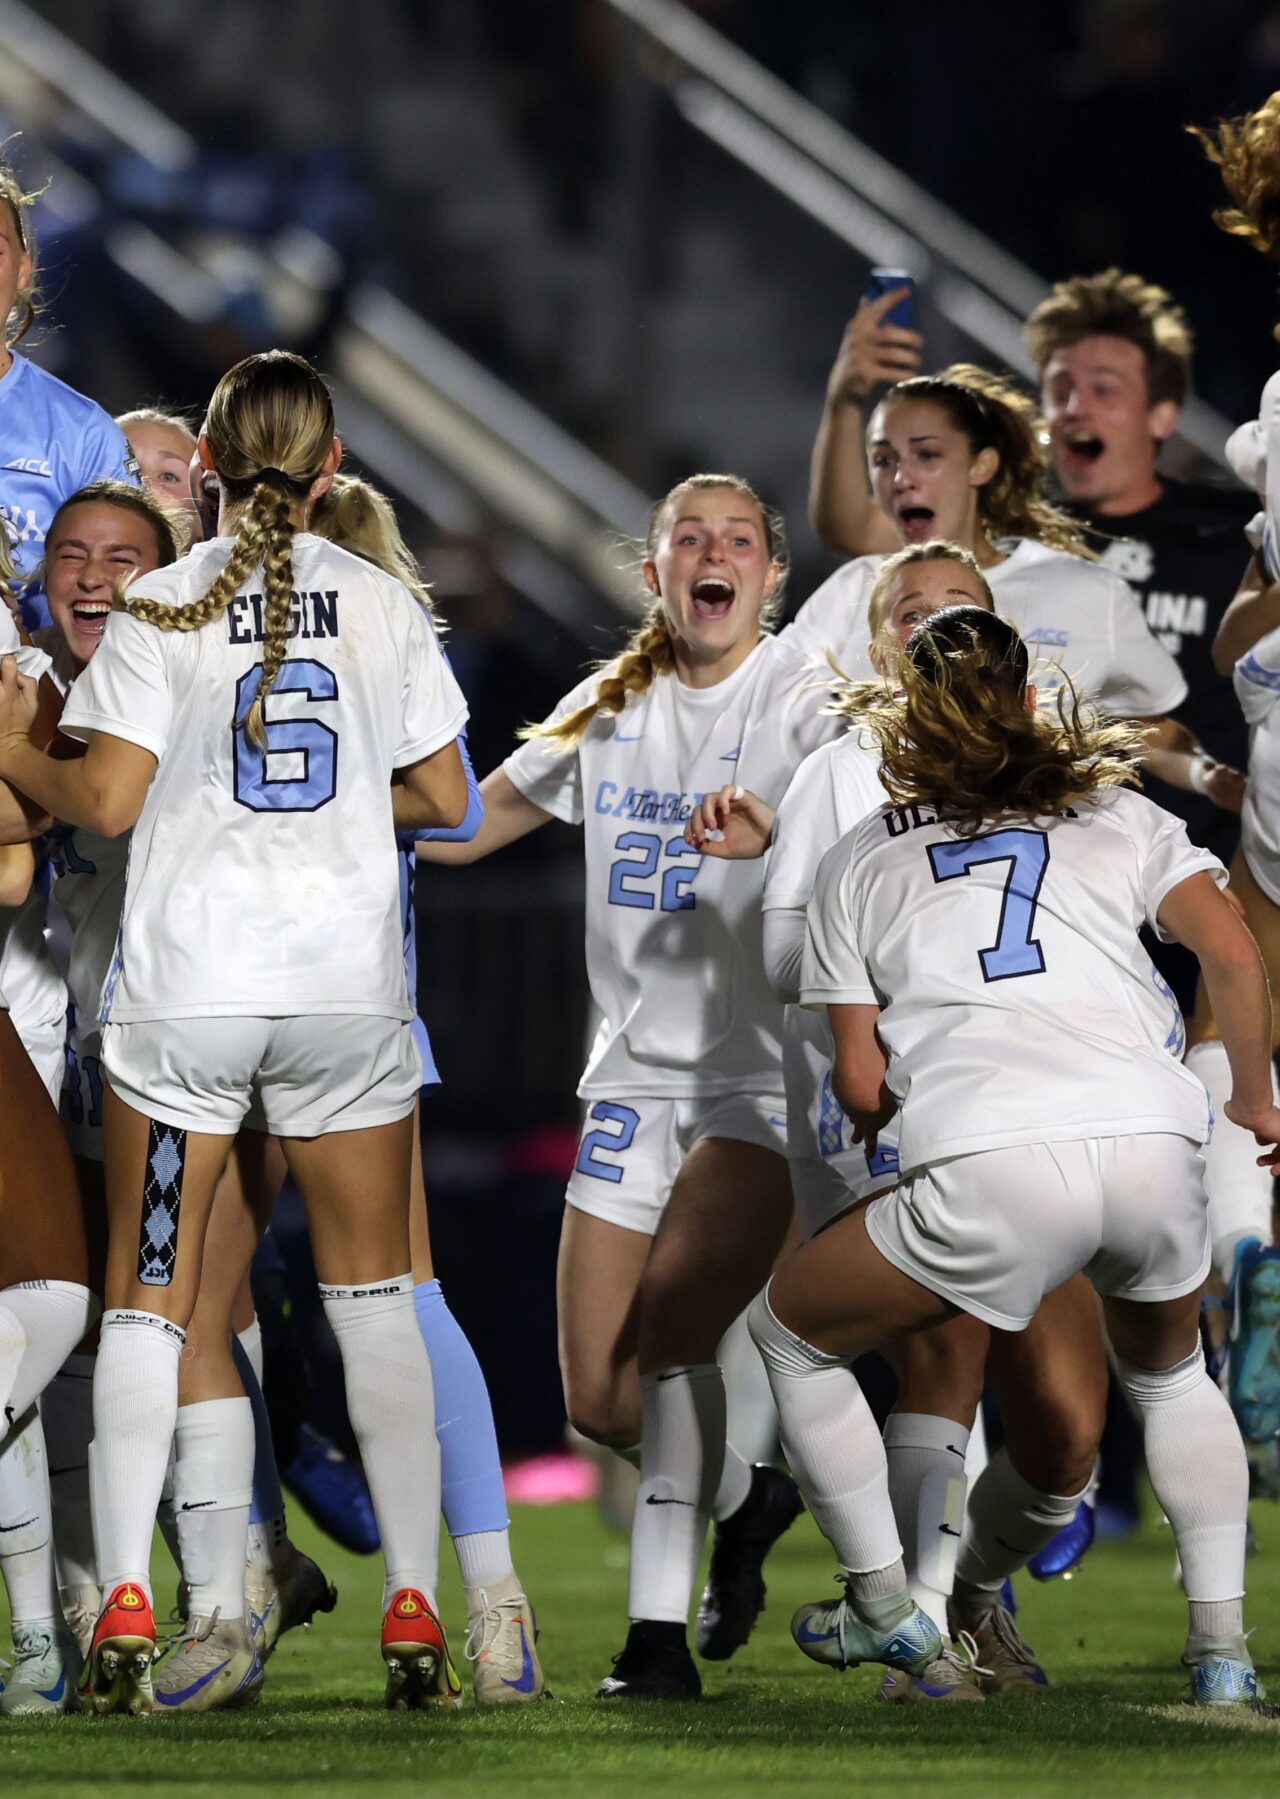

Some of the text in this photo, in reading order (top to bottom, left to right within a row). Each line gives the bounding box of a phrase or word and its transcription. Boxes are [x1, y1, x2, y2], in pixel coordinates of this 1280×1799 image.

[1, 458, 52, 476] ACC
[227, 590, 338, 644] ELGIN
[1027, 627, 1068, 644] ACC
[233, 658, 338, 812] 6
[667, 793, 692, 822] He
[608, 830, 705, 913] 22
[925, 828, 1050, 983] 7
[575, 1101, 641, 1183] 2
[352, 1286, 400, 1298] GRIP
